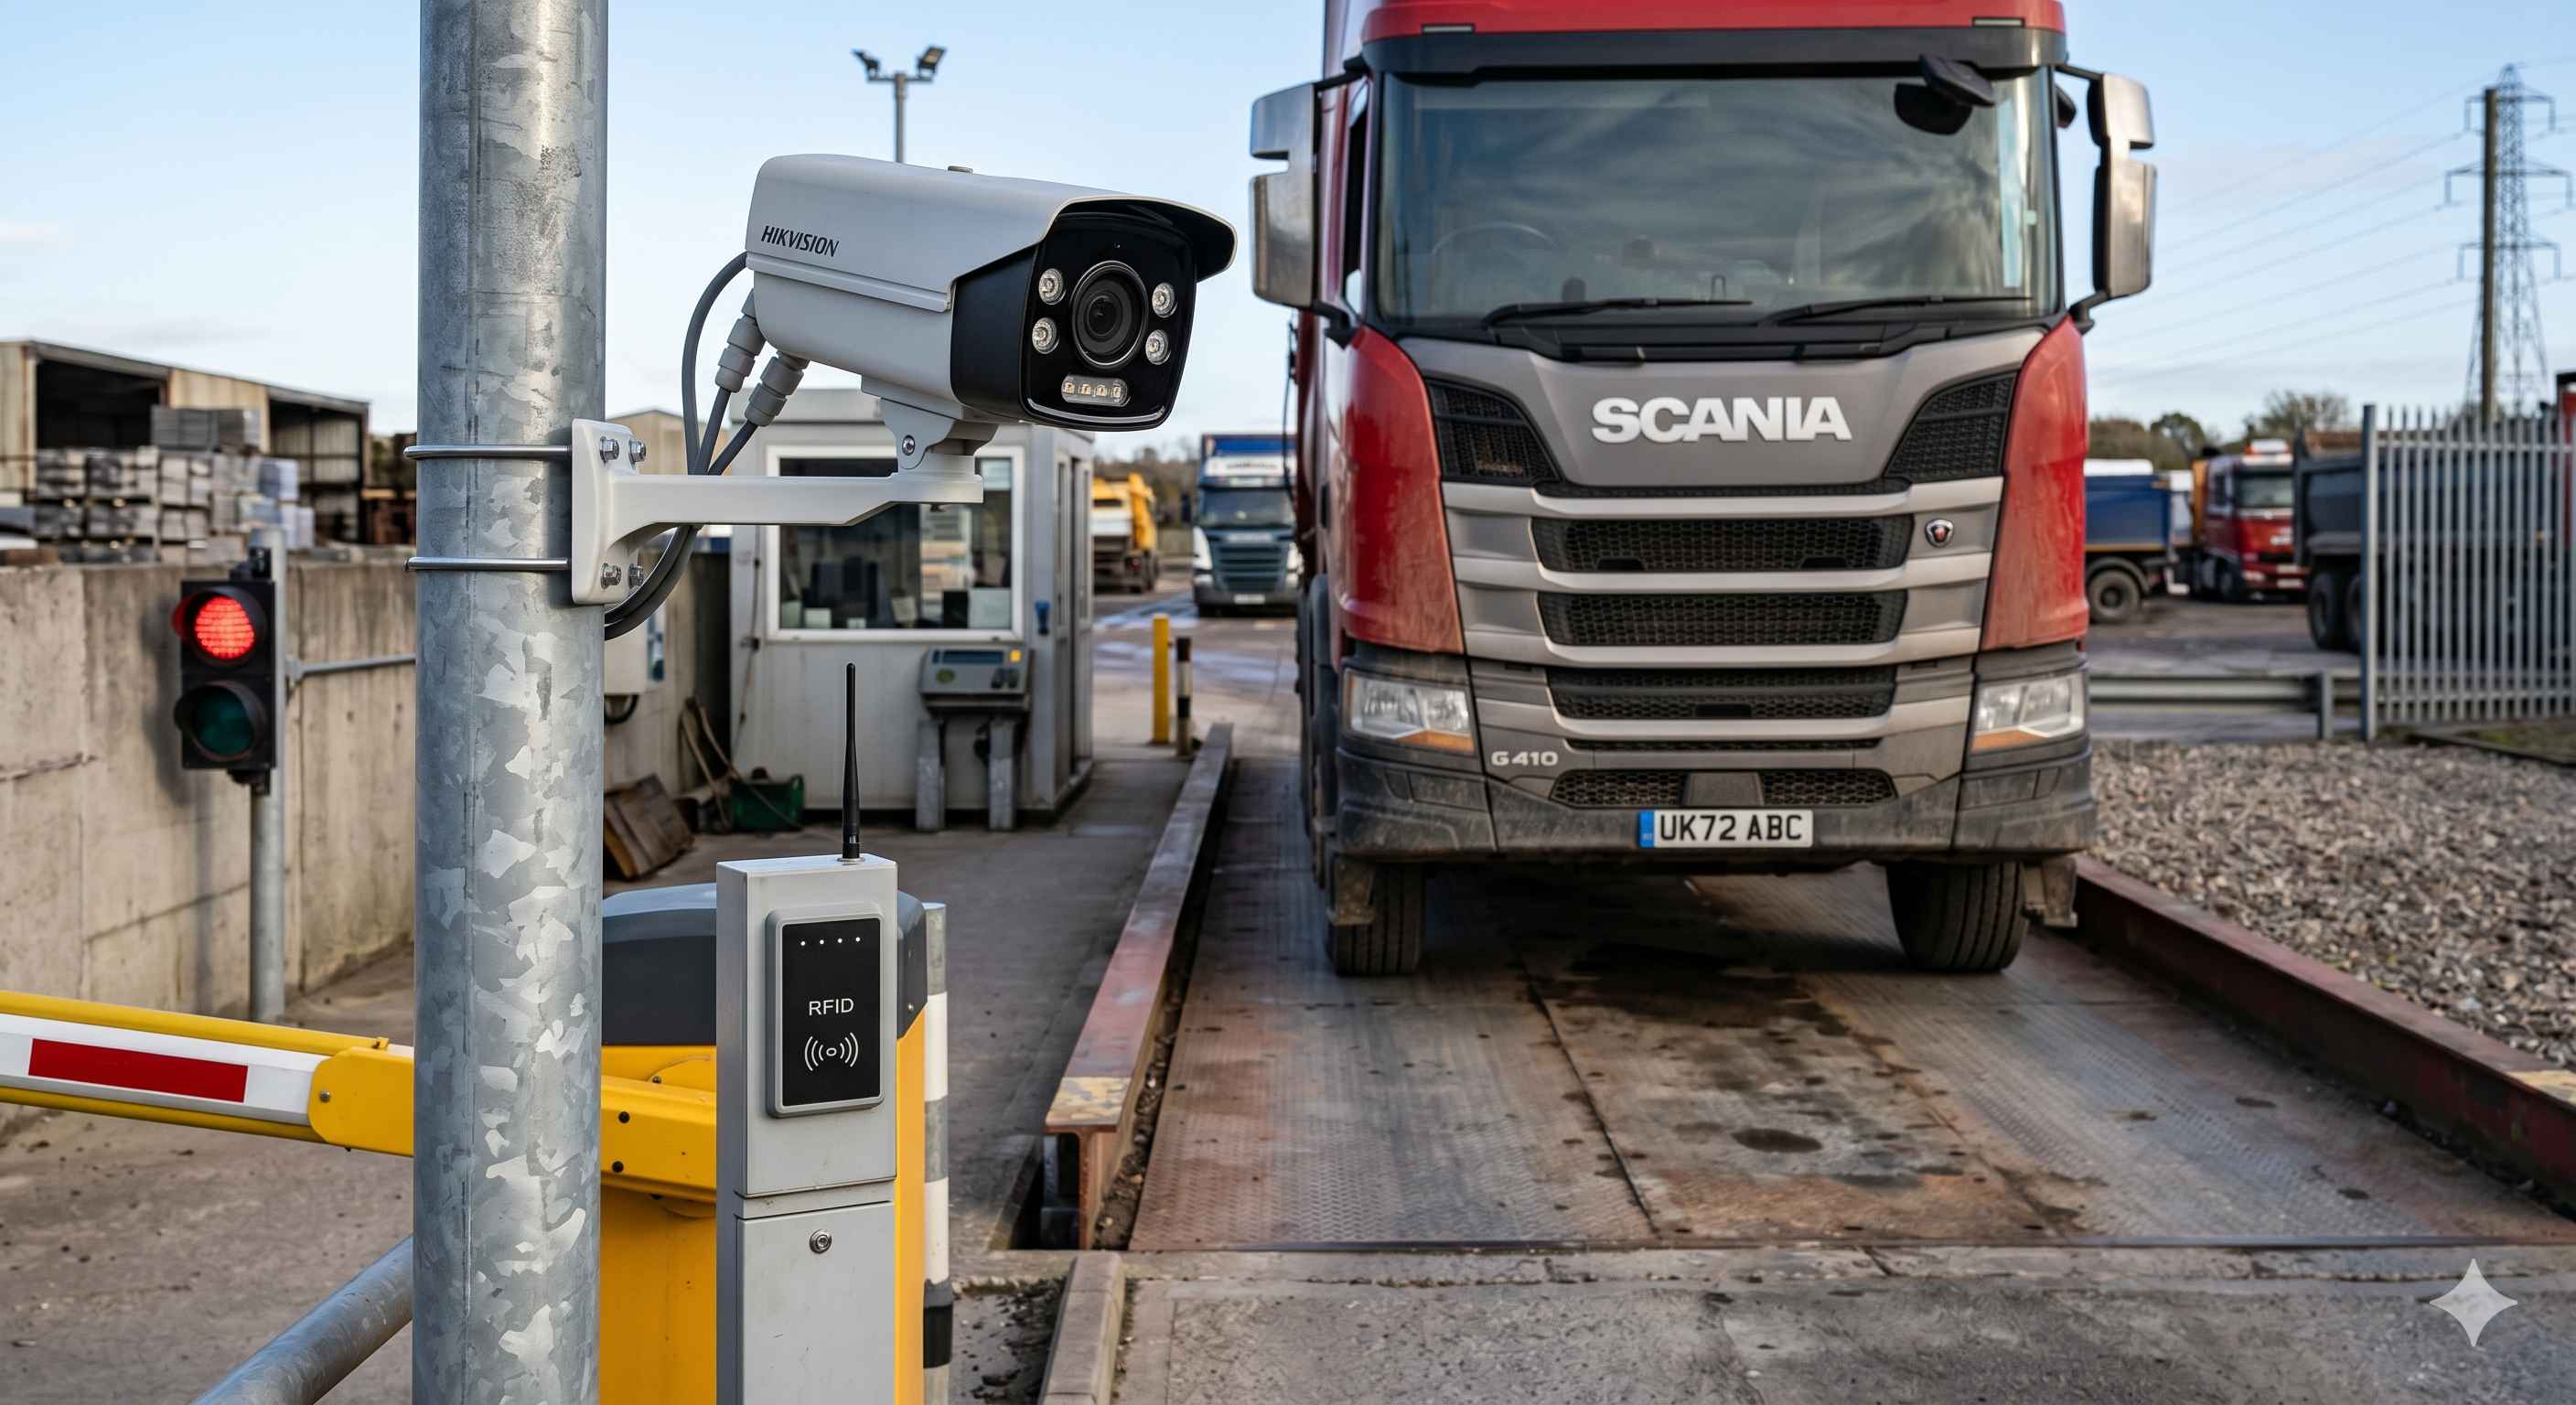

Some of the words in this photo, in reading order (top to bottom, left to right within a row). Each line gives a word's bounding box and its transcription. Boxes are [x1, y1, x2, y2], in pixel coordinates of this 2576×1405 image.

[761, 225, 839, 257] HIKVISION
[1591, 397, 1852, 443] SCANIA
[1660, 815, 1736, 841] UK72
[1746, 815, 1803, 841] ABC
[808, 998, 854, 1016] RFID
